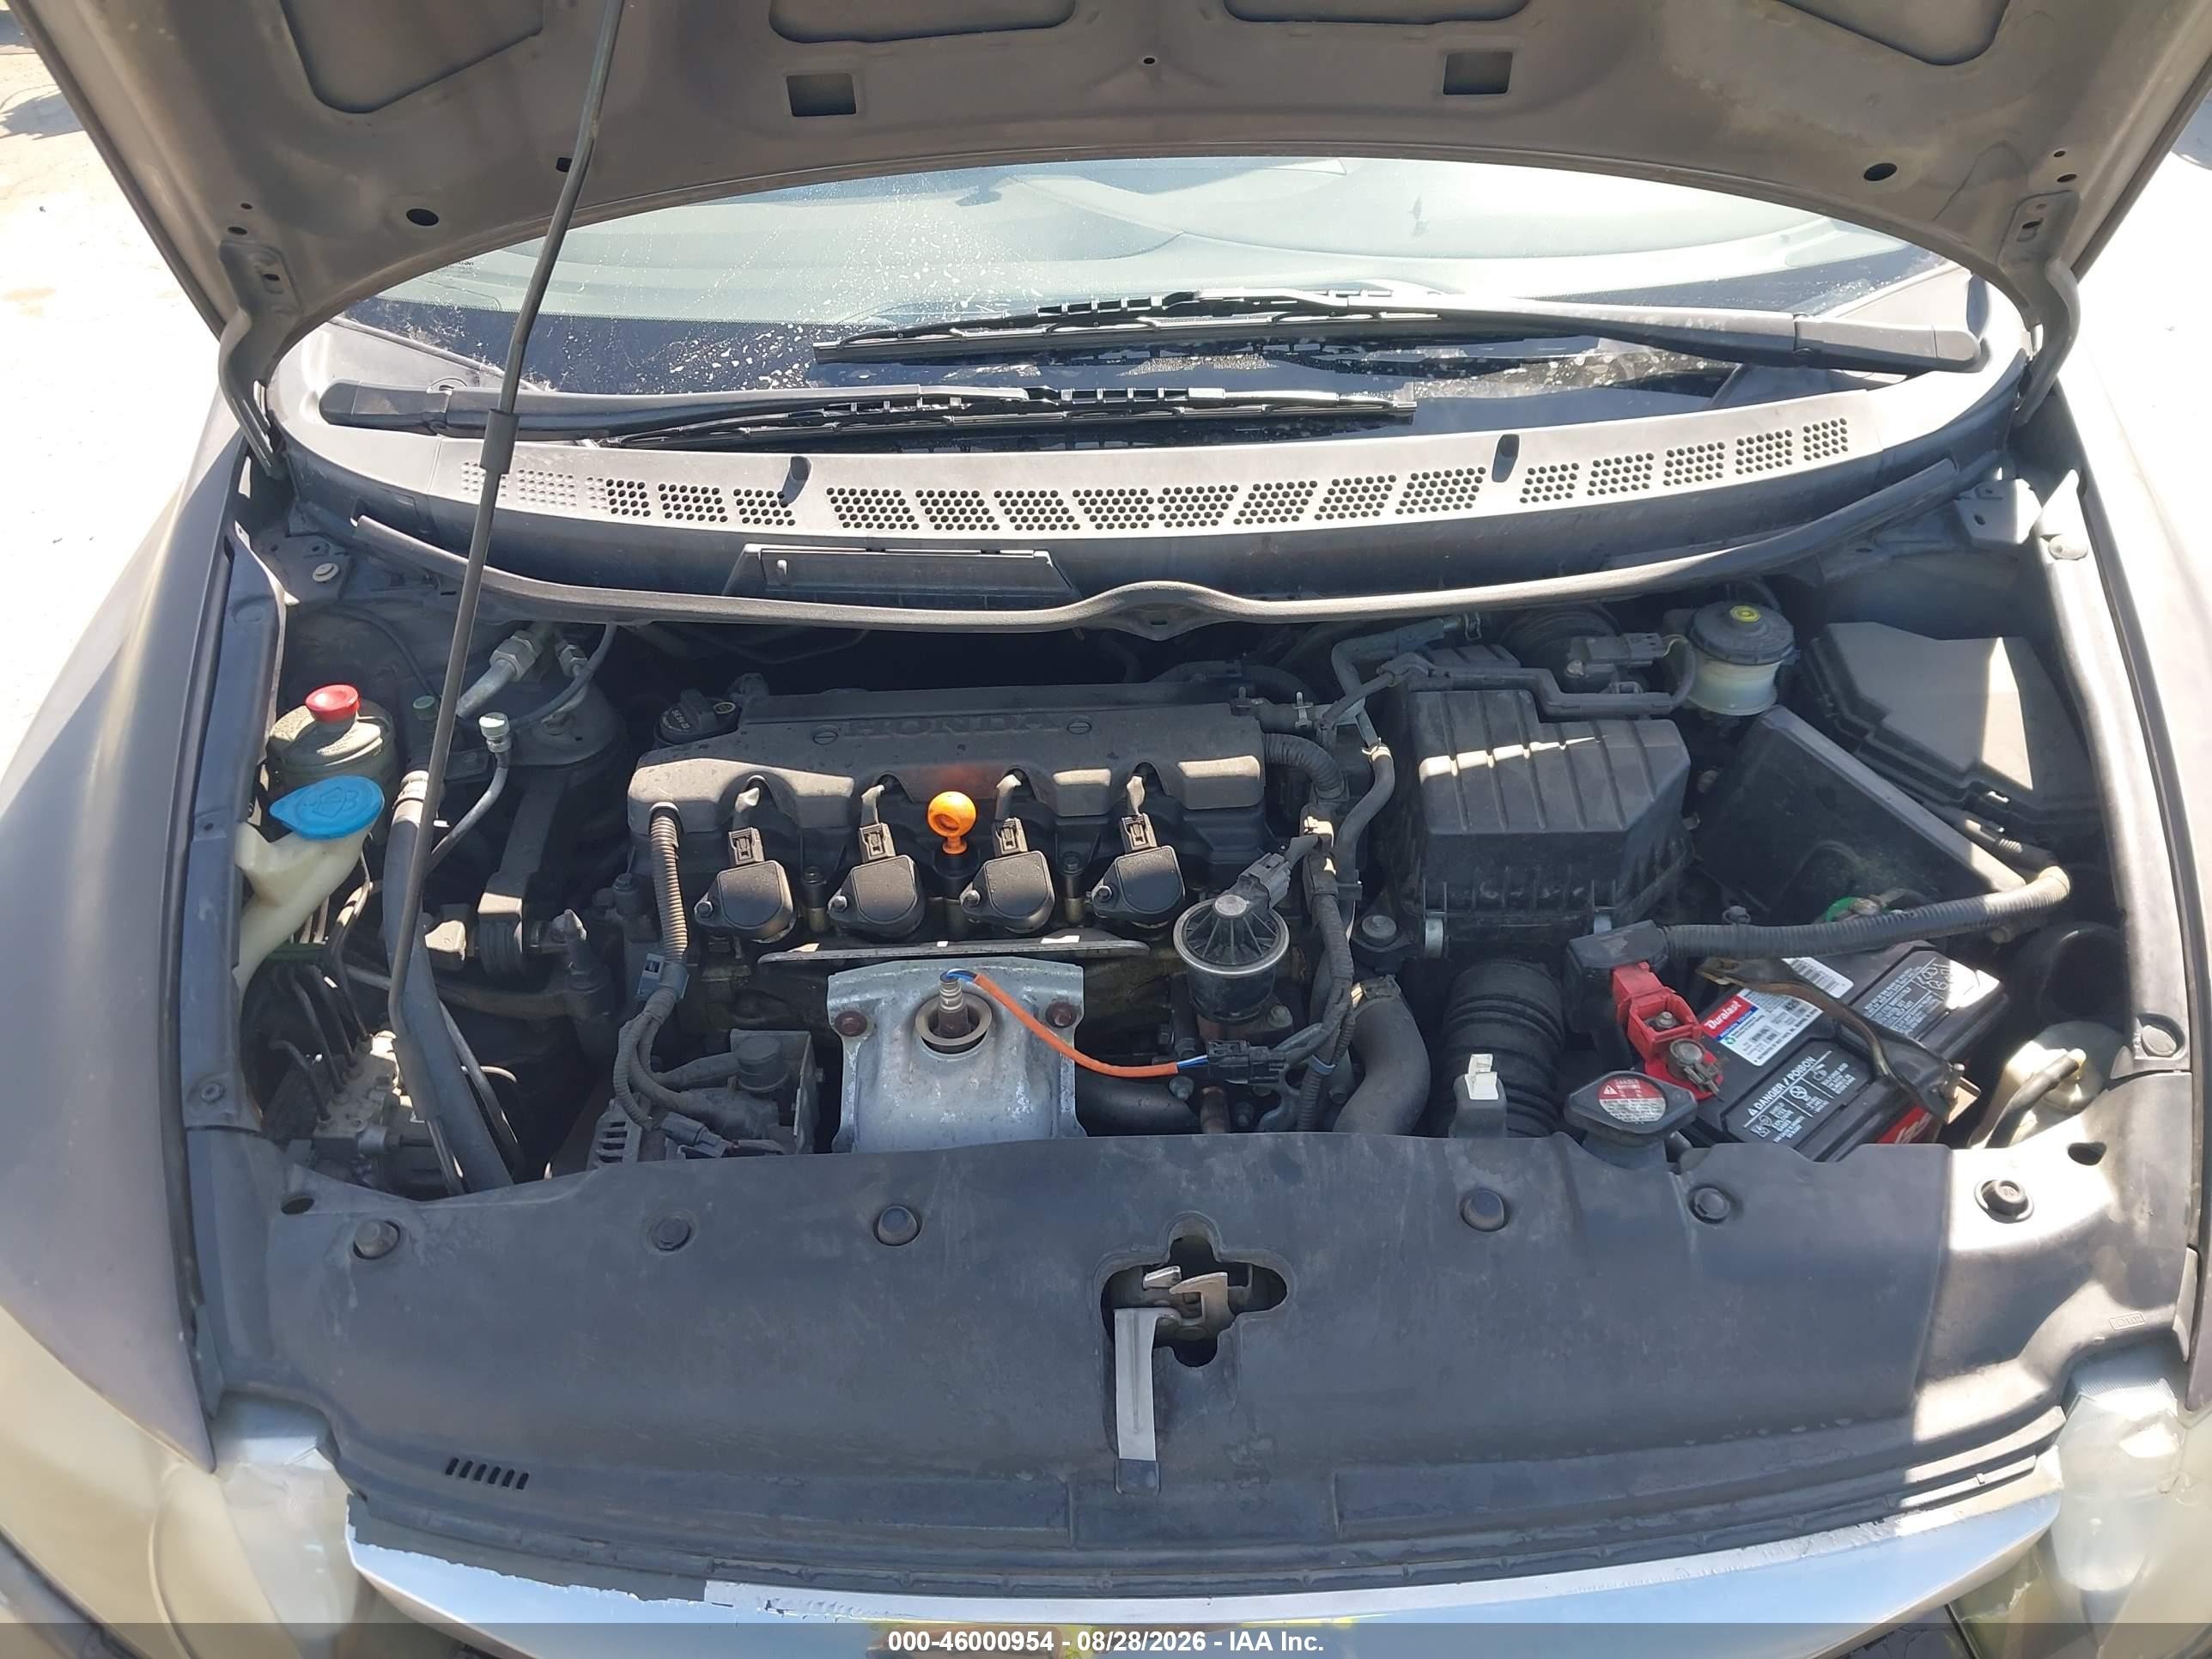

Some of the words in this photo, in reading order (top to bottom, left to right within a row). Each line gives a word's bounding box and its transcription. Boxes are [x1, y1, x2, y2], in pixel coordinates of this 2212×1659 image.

[845, 709, 1061, 738] HONDA
[1704, 1000, 1742, 1030] Duralast
[1753, 1082, 1785, 1109] DANGER
[1787, 1055, 1817, 1079] POISON
